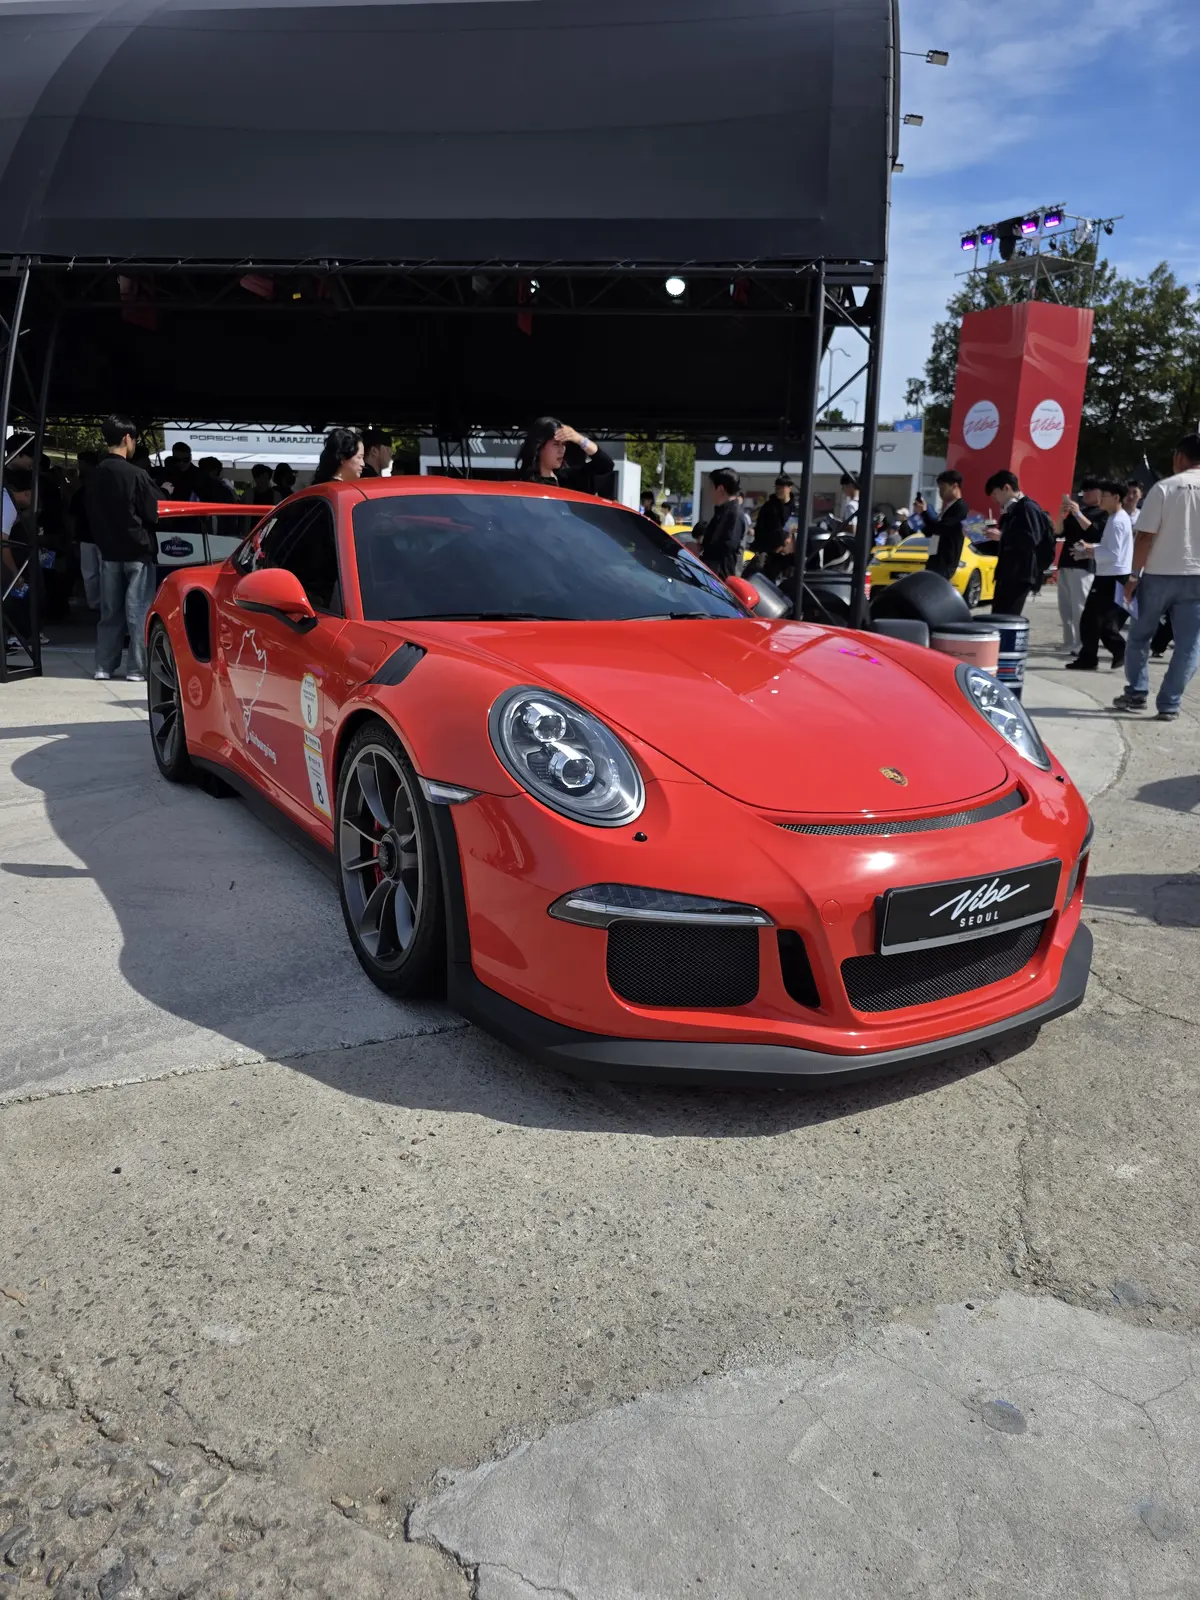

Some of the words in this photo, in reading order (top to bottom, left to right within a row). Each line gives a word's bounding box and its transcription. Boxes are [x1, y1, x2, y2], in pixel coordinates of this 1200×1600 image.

[316, 782, 324, 805] 8
[929, 877, 1030, 920] Vibe
[959, 911, 999, 927] SEOUL
